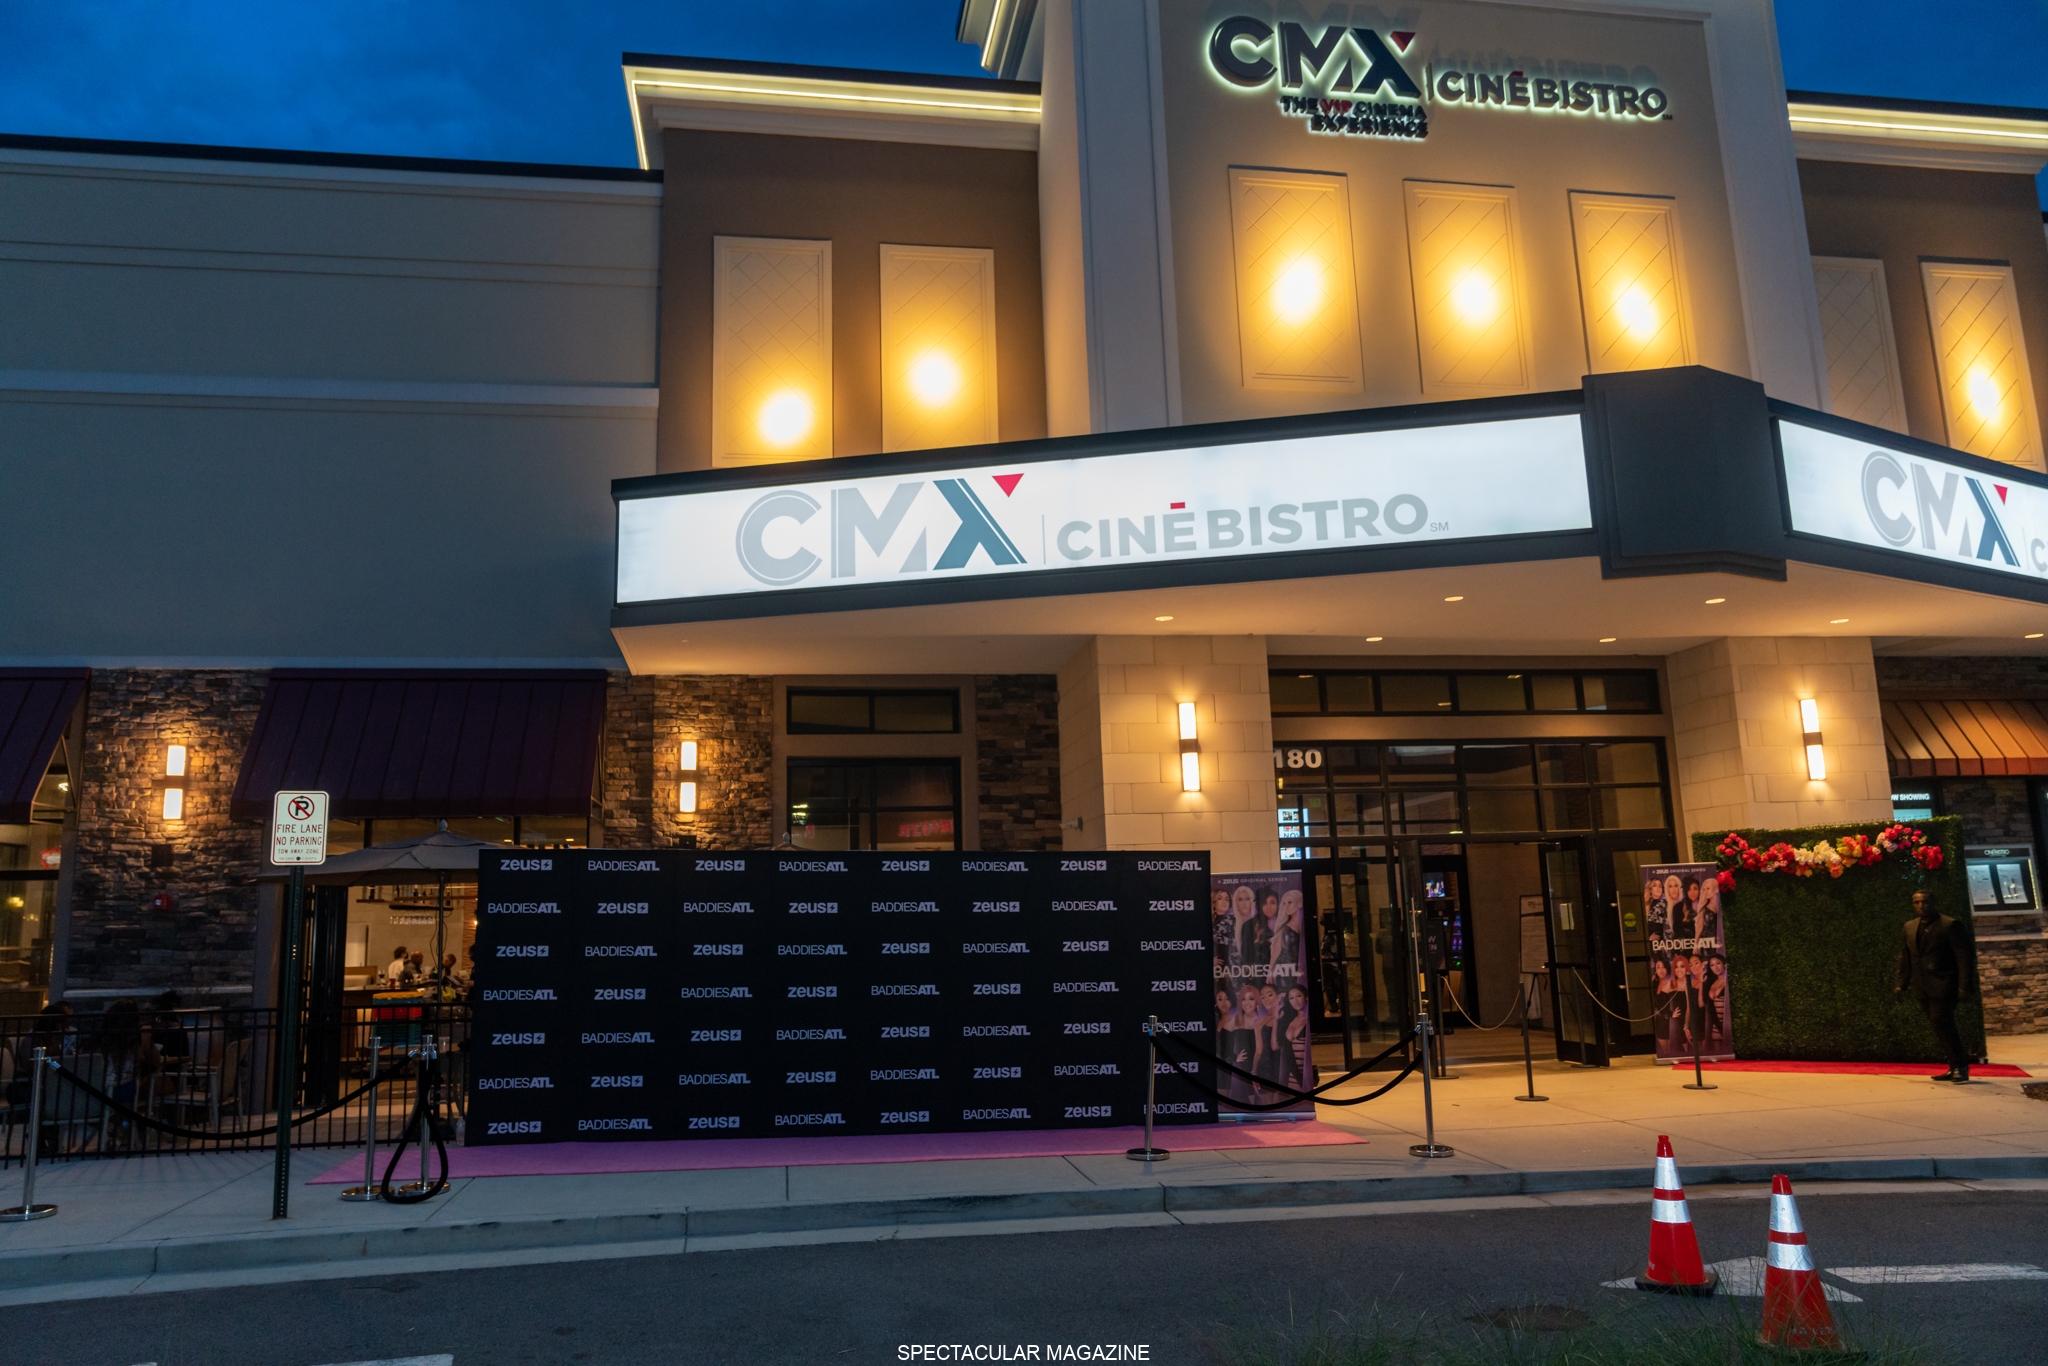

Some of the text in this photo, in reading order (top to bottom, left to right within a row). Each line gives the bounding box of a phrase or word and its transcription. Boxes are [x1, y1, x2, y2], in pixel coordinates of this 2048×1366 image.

[1210, 15, 1421, 99] CMX
[1280, 96, 1427, 120] THE VIP CINEMA
[1311, 114, 1429, 139] EXPERIENCE
[1861, 450, 2021, 568] CMX
[735, 472, 1028, 586] CMX
[1429, 521, 1450, 533] SM
[1899, 792, 1931, 801] SHOWING
[277, 824, 322, 833] FIRE LANE
[276, 837, 322, 845] NO PARKING
[500, 859, 540, 871] zeus
[587, 860, 661, 872] BADDIESATL
[694, 859, 733, 872] zeus
[779, 861, 849, 872] BADDIESATL
[881, 860, 918, 872] zeus
[961, 861, 1029, 872] BADDIESATL
[1060, 859, 1095, 872] zeus
[1137, 860, 1202, 872] BADDIESATL
[487, 902, 562, 914] BADDIESATL
[597, 902, 636, 915] zeus
[683, 901, 755, 913] BADDIESATL
[788, 902, 826, 914] zeus
[871, 901, 940, 913] BADDIESATL
[972, 901, 1009, 913] zeus
[1051, 900, 1118, 912] BADDIESATL
[1148, 899, 1183, 912] zeus
[692, 943, 731, 956] zeus
[777, 944, 848, 956] BADDIESATL
[881, 942, 919, 955] zeus
[962, 942, 1031, 954] BADDIESATL
[1062, 940, 1098, 952] zeus
[1140, 939, 1206, 951] BADDIESATL
[1652, 936, 1722, 951] BADDIESATL
[495, 945, 537, 958] zeus
[584, 945, 658, 957] BADDIESATL
[1213, 963, 1303, 979] BADDIESATL
[787, 985, 825, 998] zeus
[871, 984, 940, 996] BADDIESATL
[973, 983, 1009, 995] zeus
[1053, 981, 1120, 993] BADDIESATL
[1150, 979, 1185, 992] zeus
[483, 988, 558, 1001] BADDIESATL
[593, 988, 634, 1001] zeus
[681, 986, 753, 999] BADDIESATL
[880, 1025, 918, 1039] zeus
[963, 1024, 1031, 1037] BADDIESATL
[1063, 1022, 1099, 1035] zeus
[1142, 1021, 1207, 1033] BDDIESATL
[491, 1032, 533, 1046] zeus
[581, 1031, 655, 1044] BADDIESATL
[690, 1029, 729, 1042] zeus
[776, 1028, 847, 1041] BADDIESATL
[870, 1068, 940, 1081] BADDIESATL
[973, 1066, 1010, 1079] zeus
[1053, 1063, 1121, 1076] BADDIESATL
[478, 1076, 555, 1090] BADDIESATL
[590, 1075, 631, 1088] zeus
[678, 1072, 751, 1086] BADDIESATL
[785, 1070, 824, 1084] zeus
[880, 1110, 918, 1124] zeus
[963, 1107, 1032, 1120] BADDIESATL
[1064, 1105, 1100, 1118] zeus
[577, 1118, 653, 1131] BADDIESATL
[688, 1116, 727, 1130] zeus
[774, 1112, 846, 1126] BADDIESATL
[487, 1120, 529, 1135] zeus
